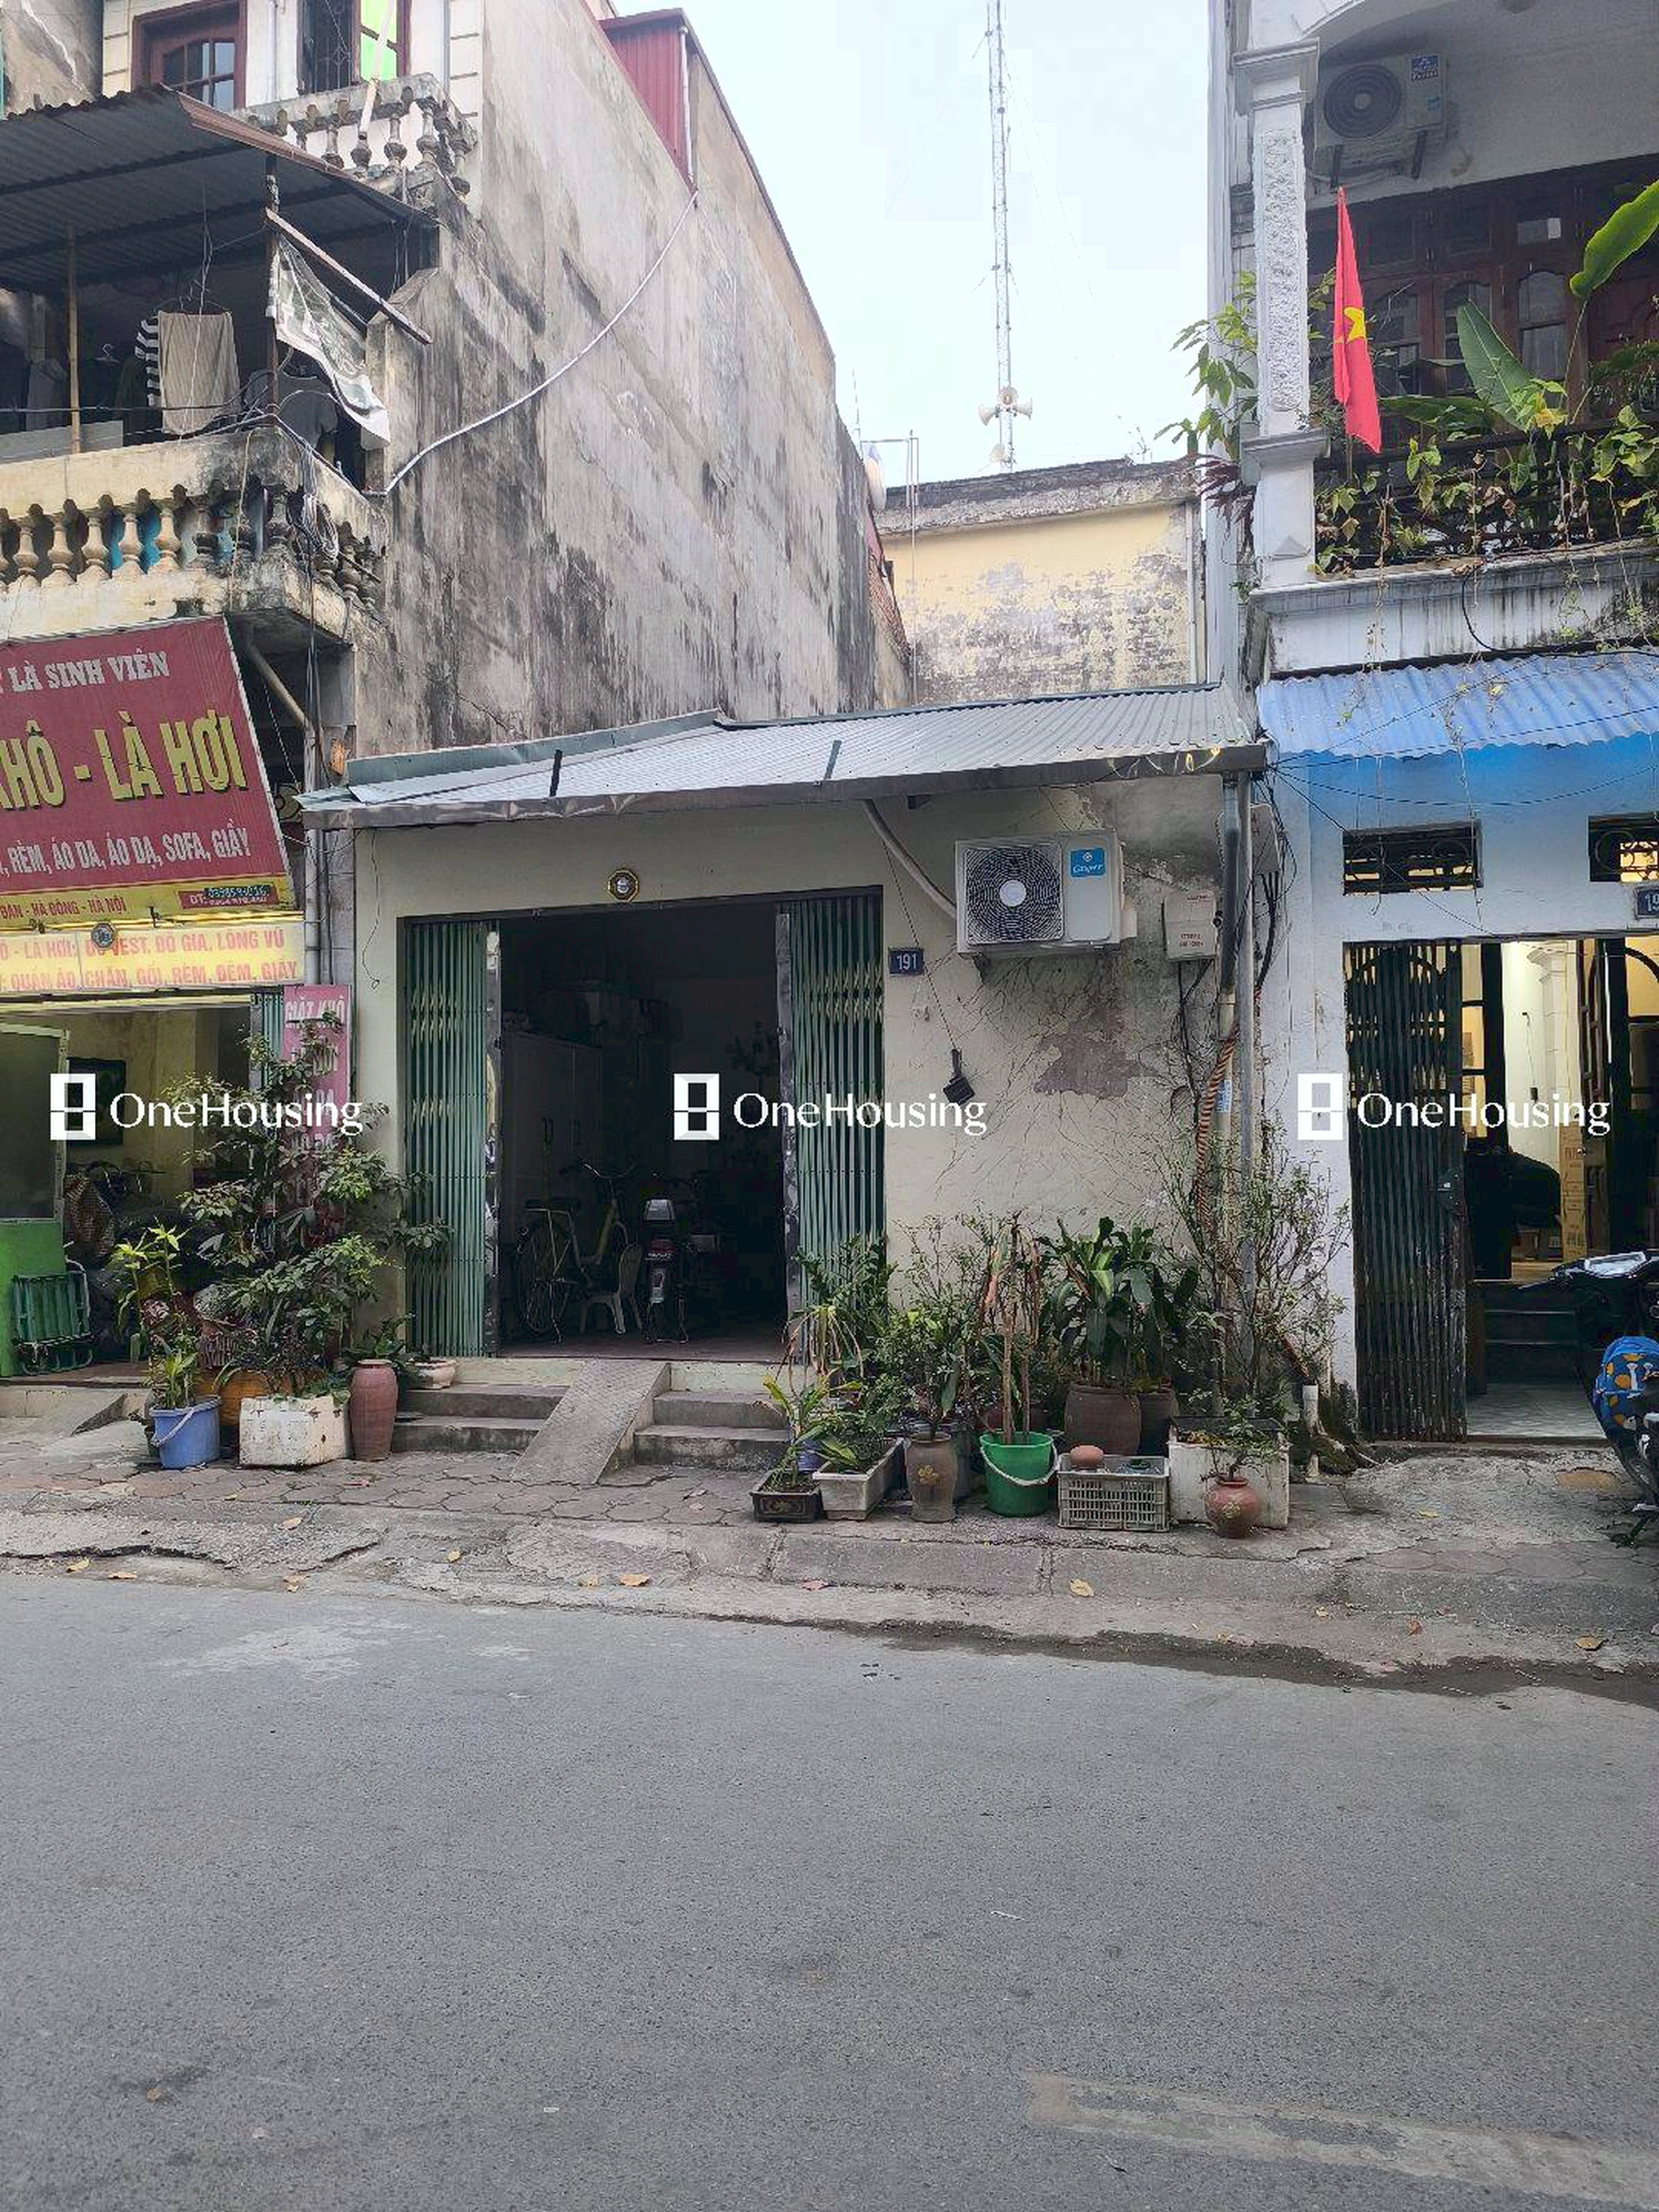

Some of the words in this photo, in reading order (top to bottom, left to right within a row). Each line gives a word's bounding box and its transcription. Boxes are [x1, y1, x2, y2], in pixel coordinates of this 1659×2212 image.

[8, 660, 42, 692] LÀ
[45, 659, 105, 688] SINH
[107, 648, 170, 682] VIÊN
[0, 719, 65, 809] HÔ
[94, 711, 163, 800] LÀ
[159, 709, 247, 794] HƠI
[162, 832, 212, 863] SOFA,
[105, 895, 127, 915] NỘI
[896, 953, 917, 970] 191
